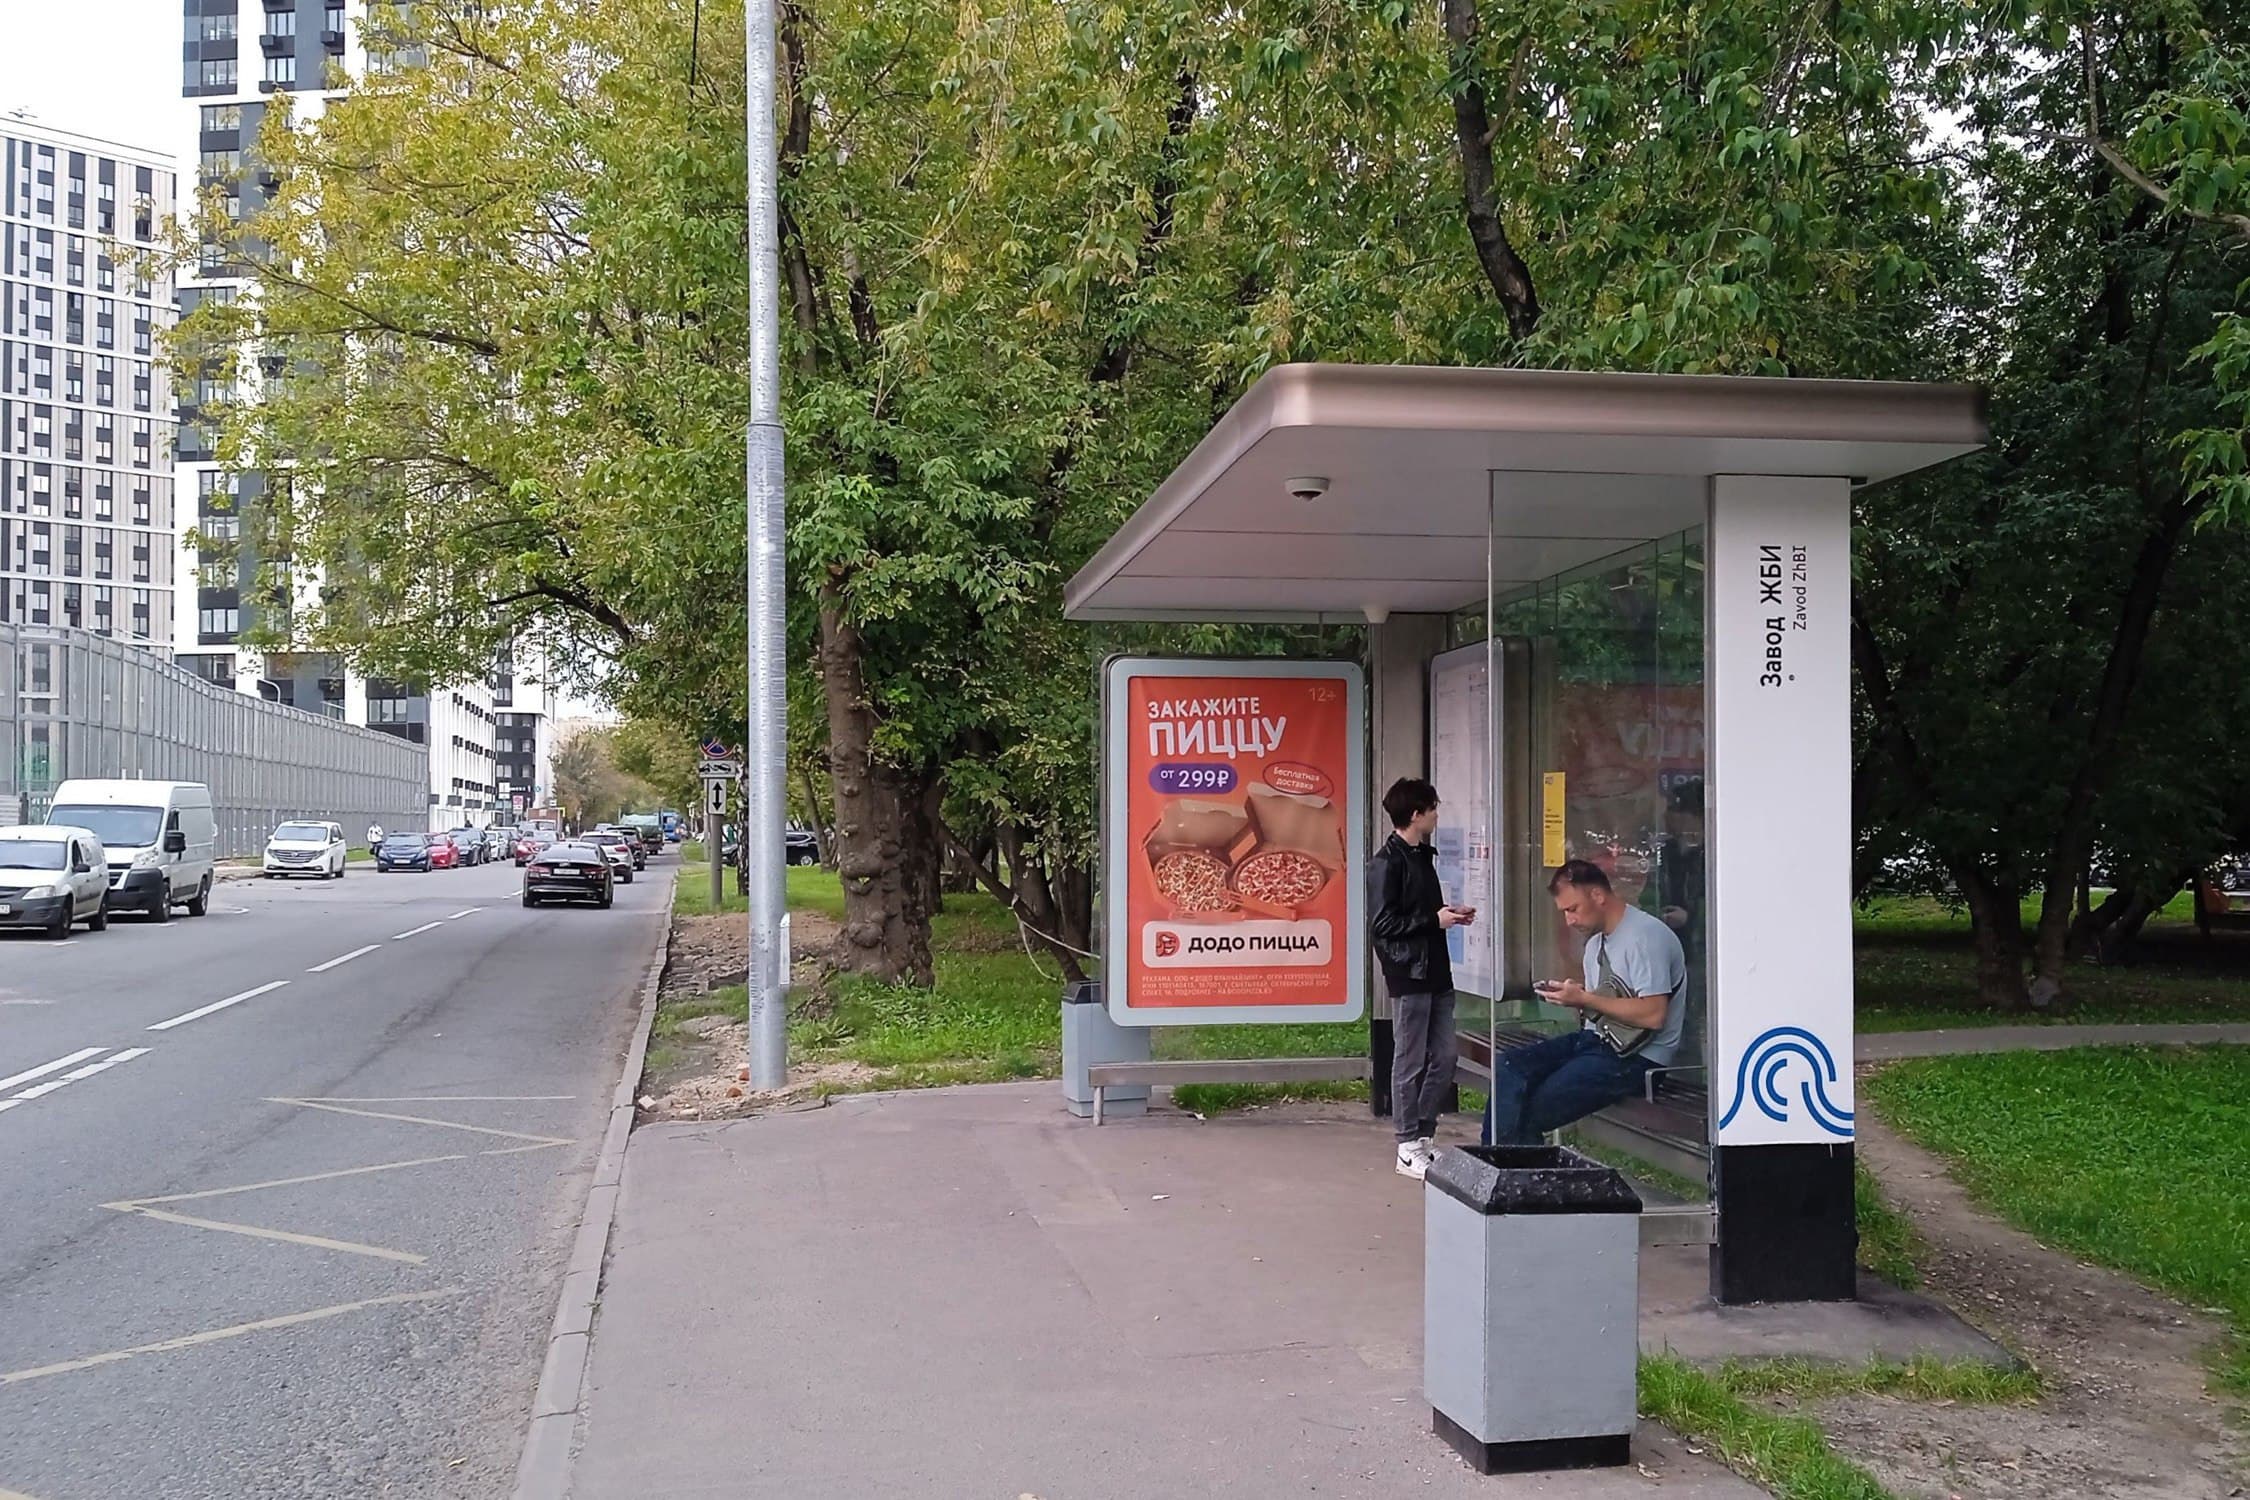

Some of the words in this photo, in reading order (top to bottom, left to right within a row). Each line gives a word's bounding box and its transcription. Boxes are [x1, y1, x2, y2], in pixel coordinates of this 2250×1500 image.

[1760, 545, 1782, 605] ЖБИ
[1792, 545, 1807, 582] ZhBI
[1792, 586, 1807, 631] Zavod
[1760, 616, 1786, 688] Завод
[1148, 697, 1261, 718] ЗАКАЖИТЕ
[1308, 687, 1337, 702] 12+
[1149, 716, 1287, 760] ПИЦЦУ
[1178, 769, 1230, 788] 299₽
[1188, 936, 1245, 953] ДОДО
[1249, 935, 1319, 952] ПИЦЦА
